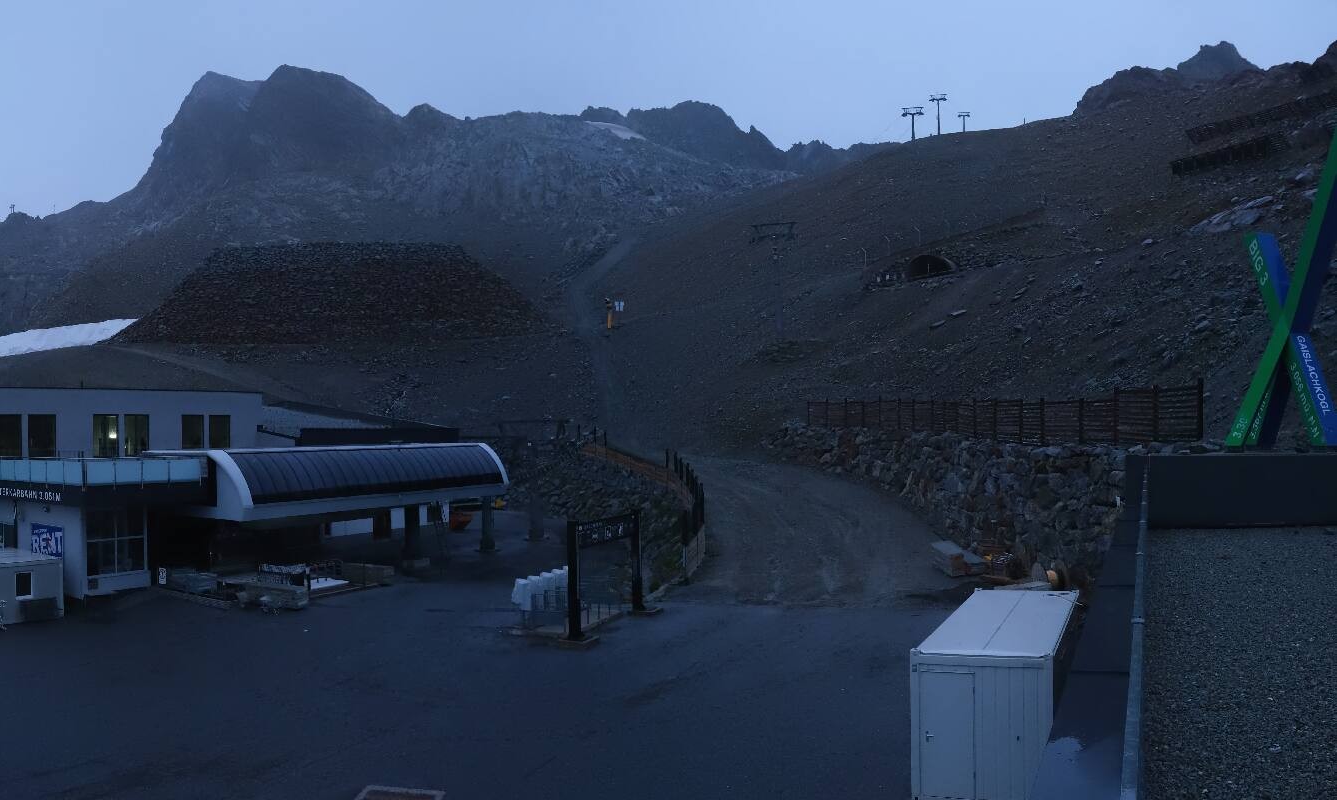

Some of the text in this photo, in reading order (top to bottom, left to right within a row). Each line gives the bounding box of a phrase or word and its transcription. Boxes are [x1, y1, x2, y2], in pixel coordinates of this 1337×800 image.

[1248, 238, 1268, 286] BIG 3
[1296, 335, 1332, 416] GAISLACHKOGL
[32, 531, 63, 556] RENT
